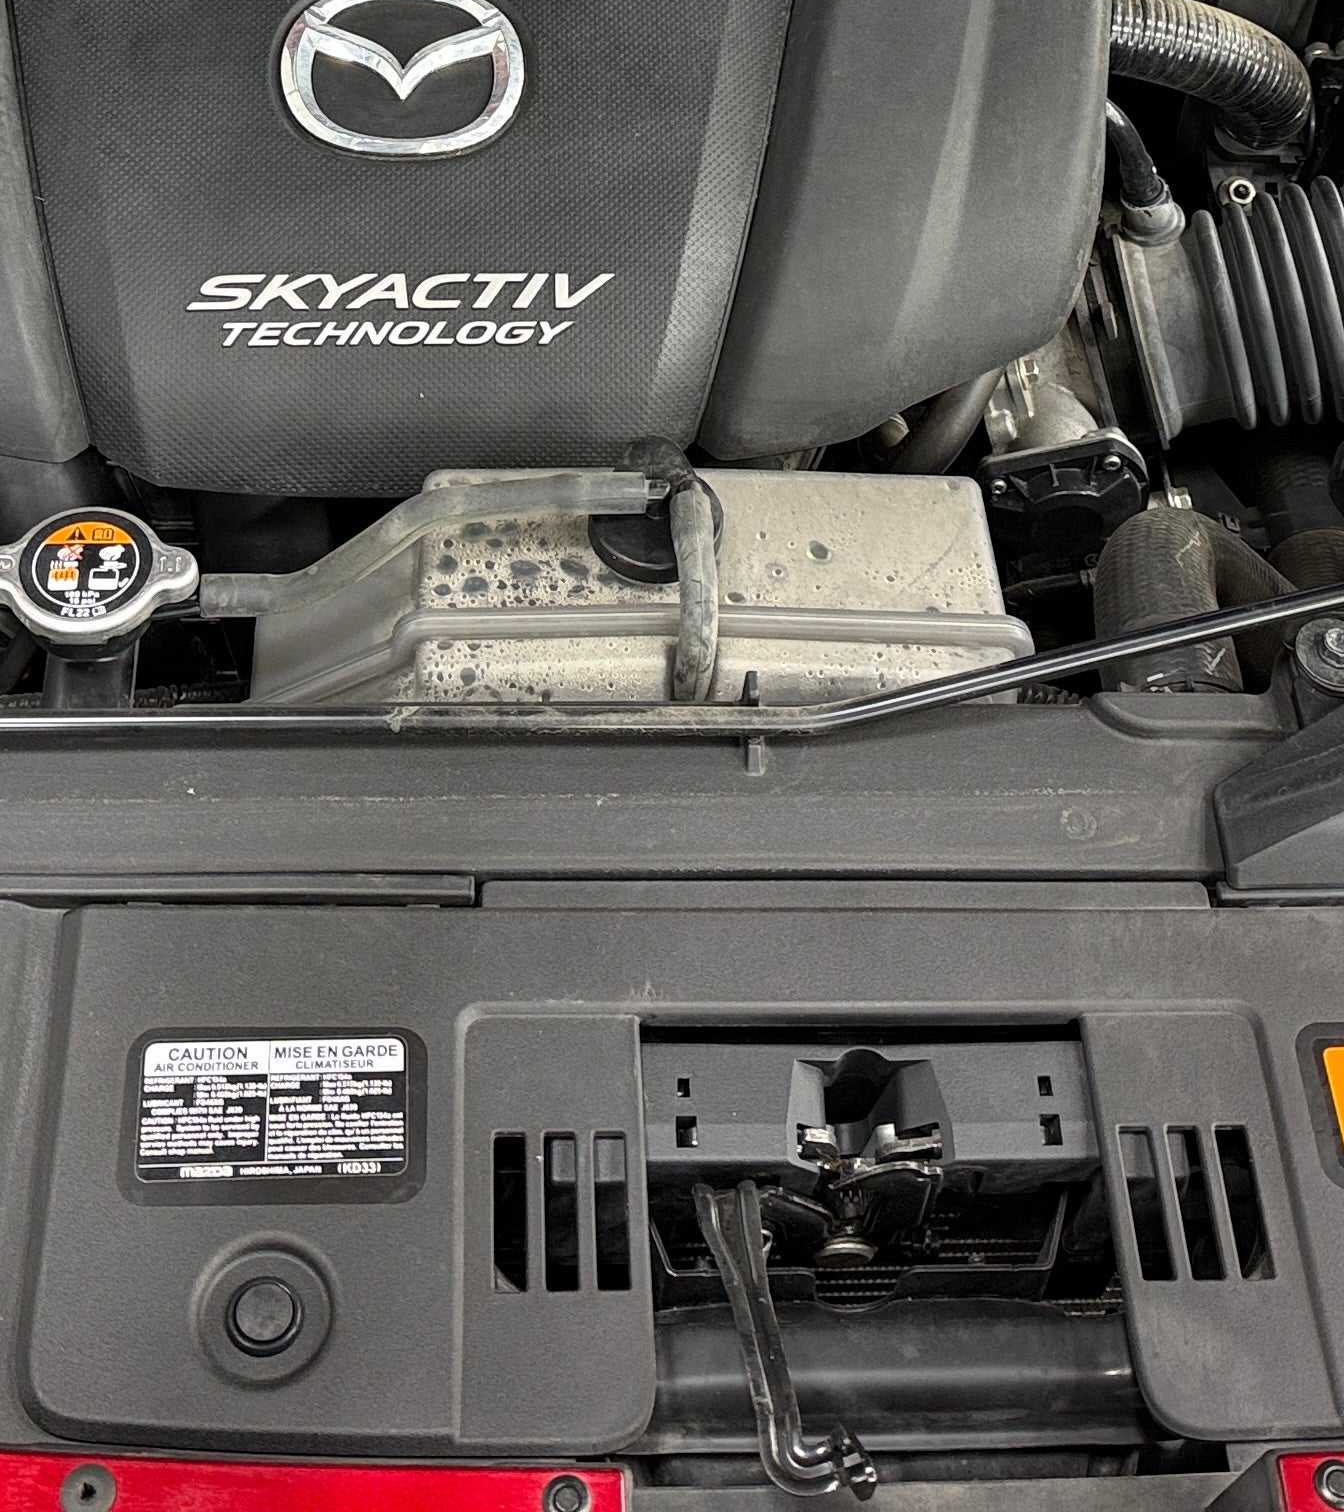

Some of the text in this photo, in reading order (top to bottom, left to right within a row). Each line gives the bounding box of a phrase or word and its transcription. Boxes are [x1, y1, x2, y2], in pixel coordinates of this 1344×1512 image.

[186, 273, 616, 312] SKYACTIV
[221, 320, 576, 348] TECHNOLOGY
[61, 606, 91, 618] FL22
[169, 1047, 248, 1061] CAUTION
[274, 1044, 398, 1059] MISE EN GARDE
[154, 1062, 259, 1072] AIR CONDITIONER
[295, 1059, 374, 1069] CLIMATISEUR
[180, 1166, 233, 1178] mazda
[337, 1162, 382, 1175] (KD33)
